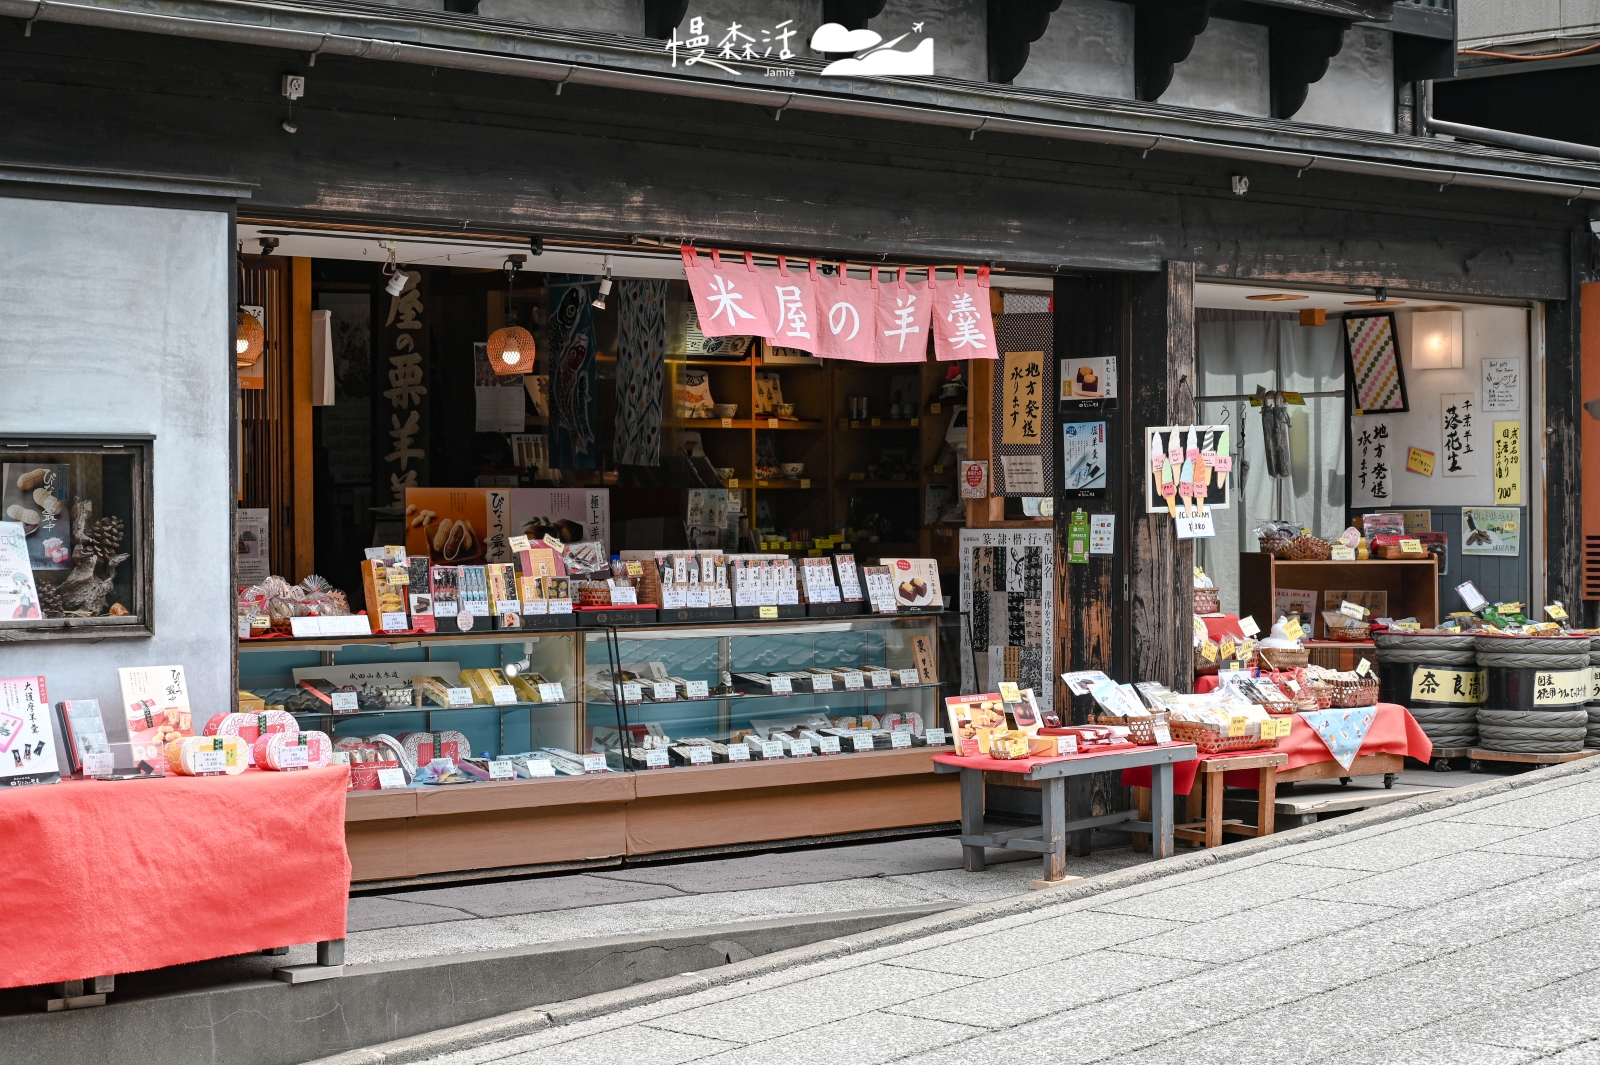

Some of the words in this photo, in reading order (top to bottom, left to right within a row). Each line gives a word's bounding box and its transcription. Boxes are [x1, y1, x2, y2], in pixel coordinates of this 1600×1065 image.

[706, 275, 987, 352] 米屋の羊羹
[1009, 367, 1024, 427] 承ります
[1022, 362, 1041, 438] 地方発送
[1462, 400, 1474, 454] 千葉半立
[1357, 430, 1373, 489] 承ります
[1370, 423, 1389, 499] 地方発送
[1444, 405, 1463, 472] 落花生
